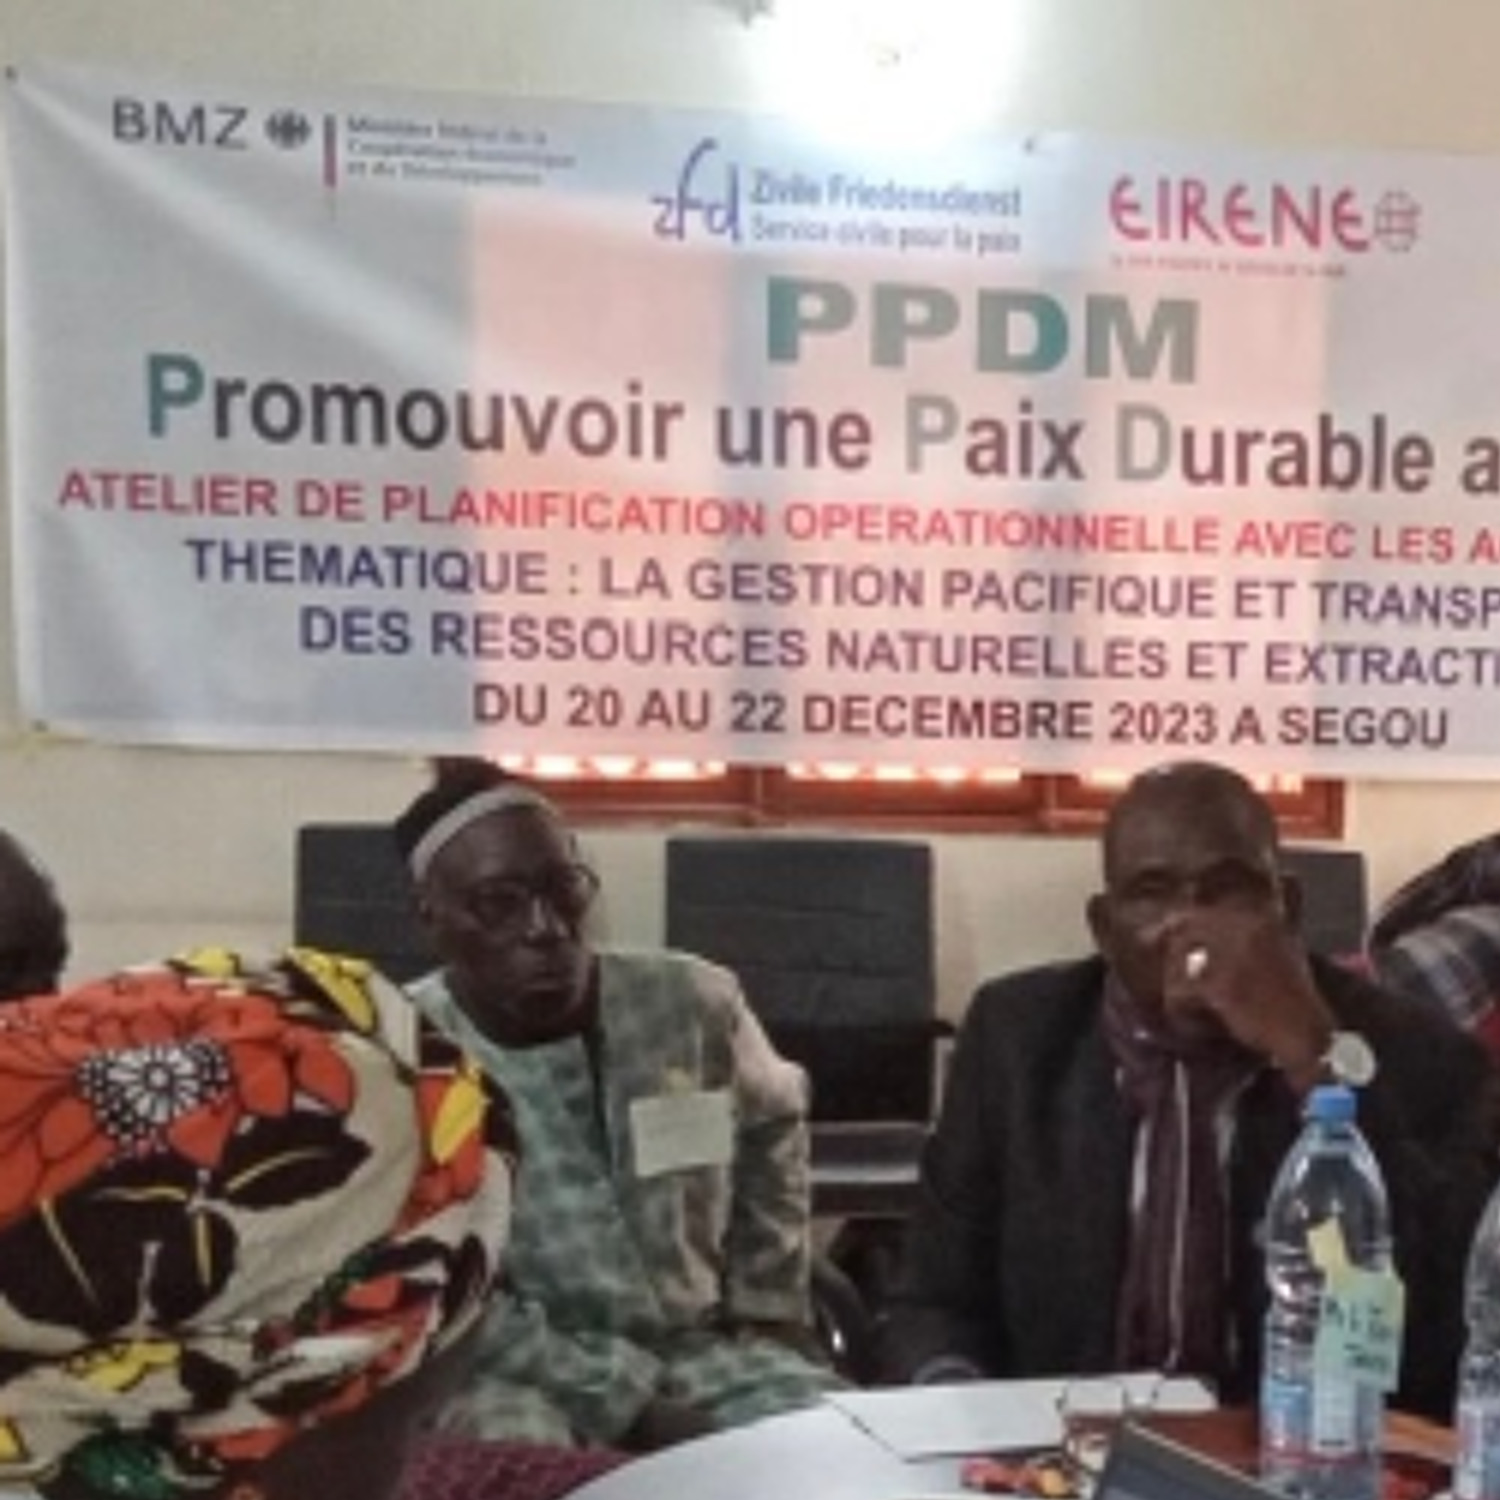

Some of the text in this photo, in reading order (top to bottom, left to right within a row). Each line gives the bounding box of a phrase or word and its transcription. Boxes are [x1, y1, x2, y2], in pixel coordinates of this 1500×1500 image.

[112, 97, 251, 149] BMZ
[752, 168, 1021, 216] Zivile Friedensdienst
[1110, 175, 1370, 252] EIRENE
[753, 211, 830, 241] Service
[899, 225, 945, 253] pour
[978, 227, 1021, 257] paix
[767, 276, 1200, 383] PPDM
[147, 352, 685, 463] Promouvoir
[717, 404, 872, 470] une
[906, 394, 1086, 481] Paix
[1117, 401, 1435, 494] Durable
[58, 470, 279, 518] ATELIER
[295, 478, 367, 522] DE
[383, 484, 765, 538] PLANIFICATION
[784, 502, 1219, 555] OPERATIONNELLE
[1235, 520, 1356, 560] AVEC
[1372, 525, 1454, 563] LES
[185, 538, 548, 596] THEMATIQUE
[601, 558, 669, 600] LA
[688, 558, 925, 608] GESTION
[942, 568, 1213, 620] PACIFIQUE
[1234, 577, 1296, 620] ET
[301, 606, 412, 656] DES
[431, 610, 807, 669] RESSOURCES
[827, 630, 1167, 680] NATURELLES
[1187, 640, 1248, 682] ET
[473, 682, 1449, 747] DU 20 AU 22 DECEMBRE 2023 A SEGOU
